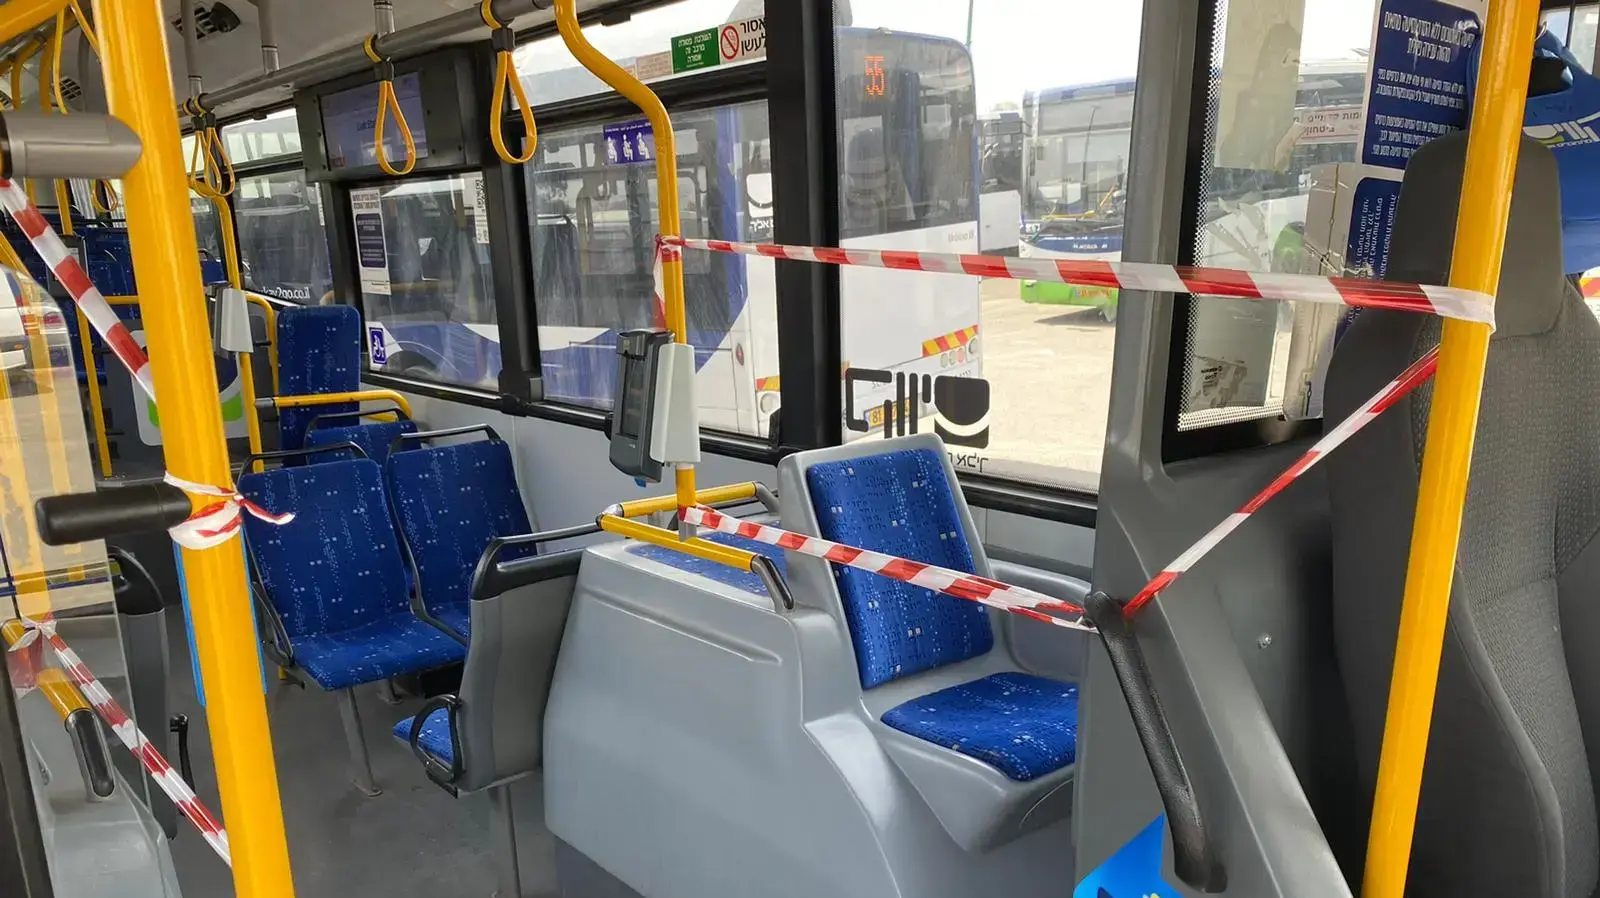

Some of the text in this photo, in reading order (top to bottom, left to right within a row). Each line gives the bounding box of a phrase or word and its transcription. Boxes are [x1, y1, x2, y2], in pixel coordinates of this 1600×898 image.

[739, 17, 766, 34] אסור
[740, 33, 766, 56] לעשן
[1356, 234, 1365, 257] נסיעה
